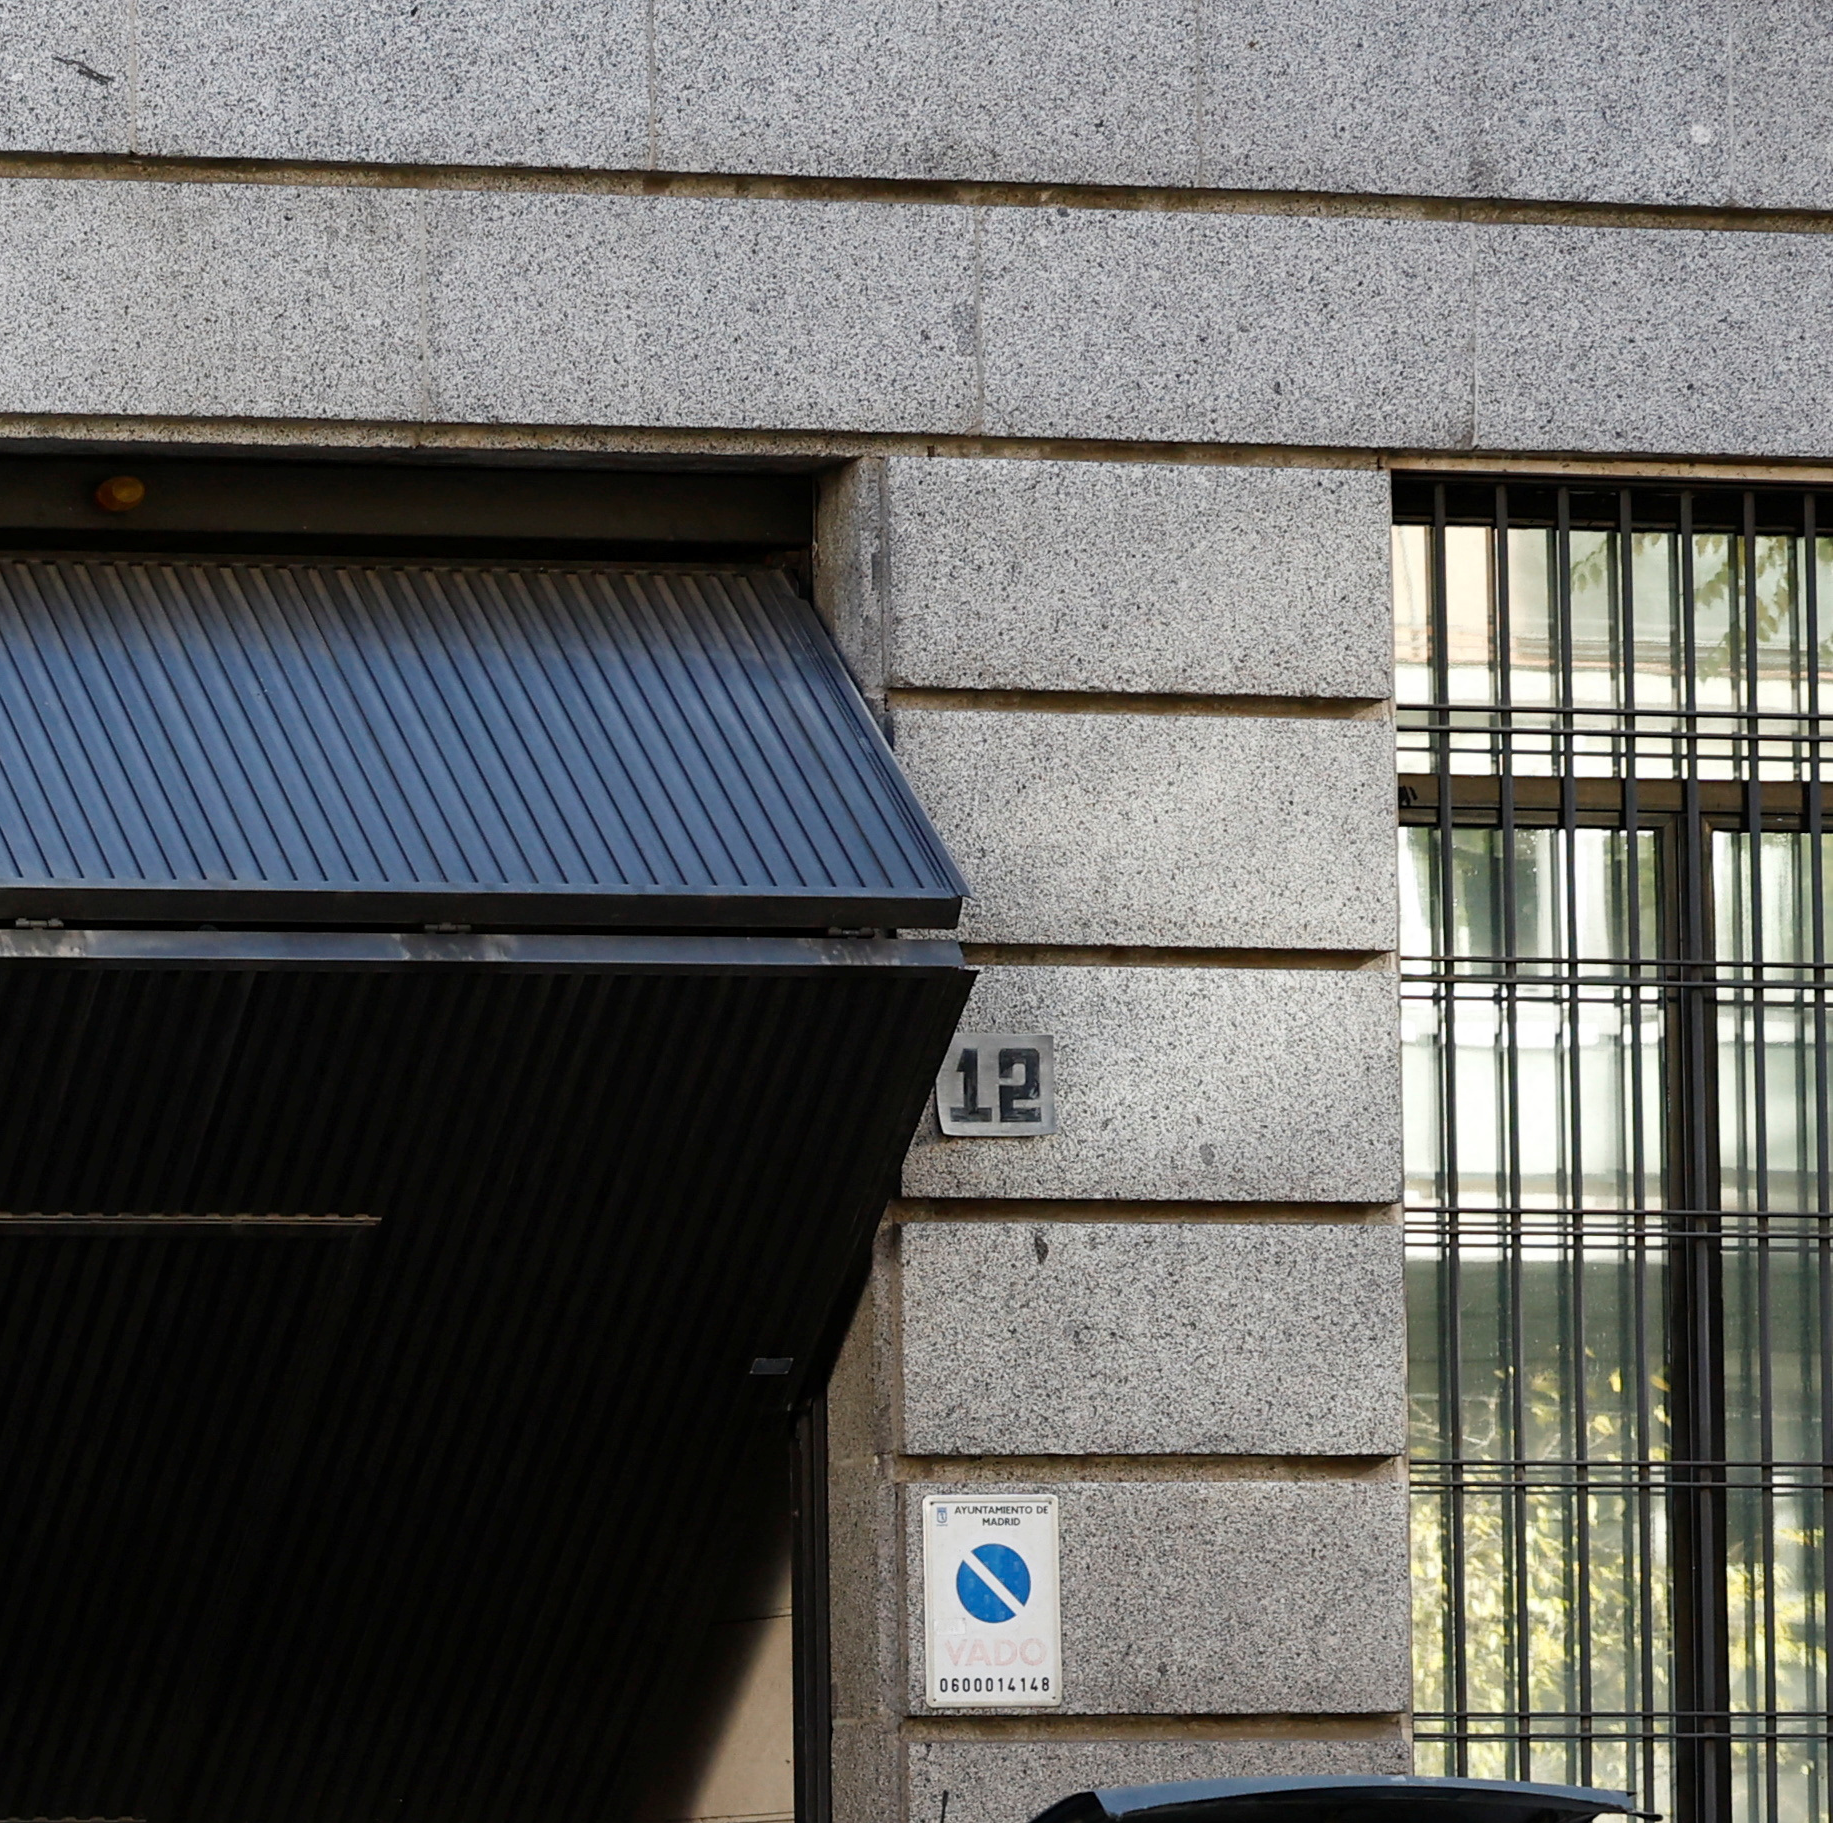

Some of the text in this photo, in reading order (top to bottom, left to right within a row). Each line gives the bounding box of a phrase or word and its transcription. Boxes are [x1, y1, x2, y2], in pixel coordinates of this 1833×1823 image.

[950, 1048, 1042, 1123] 12
[954, 1505, 1049, 1515] AYUNTAMIENTO DE
[982, 1517, 1021, 1527] MADRID
[945, 1637, 1048, 1667] VADO
[939, 1677, 1051, 1693] 0600014148
